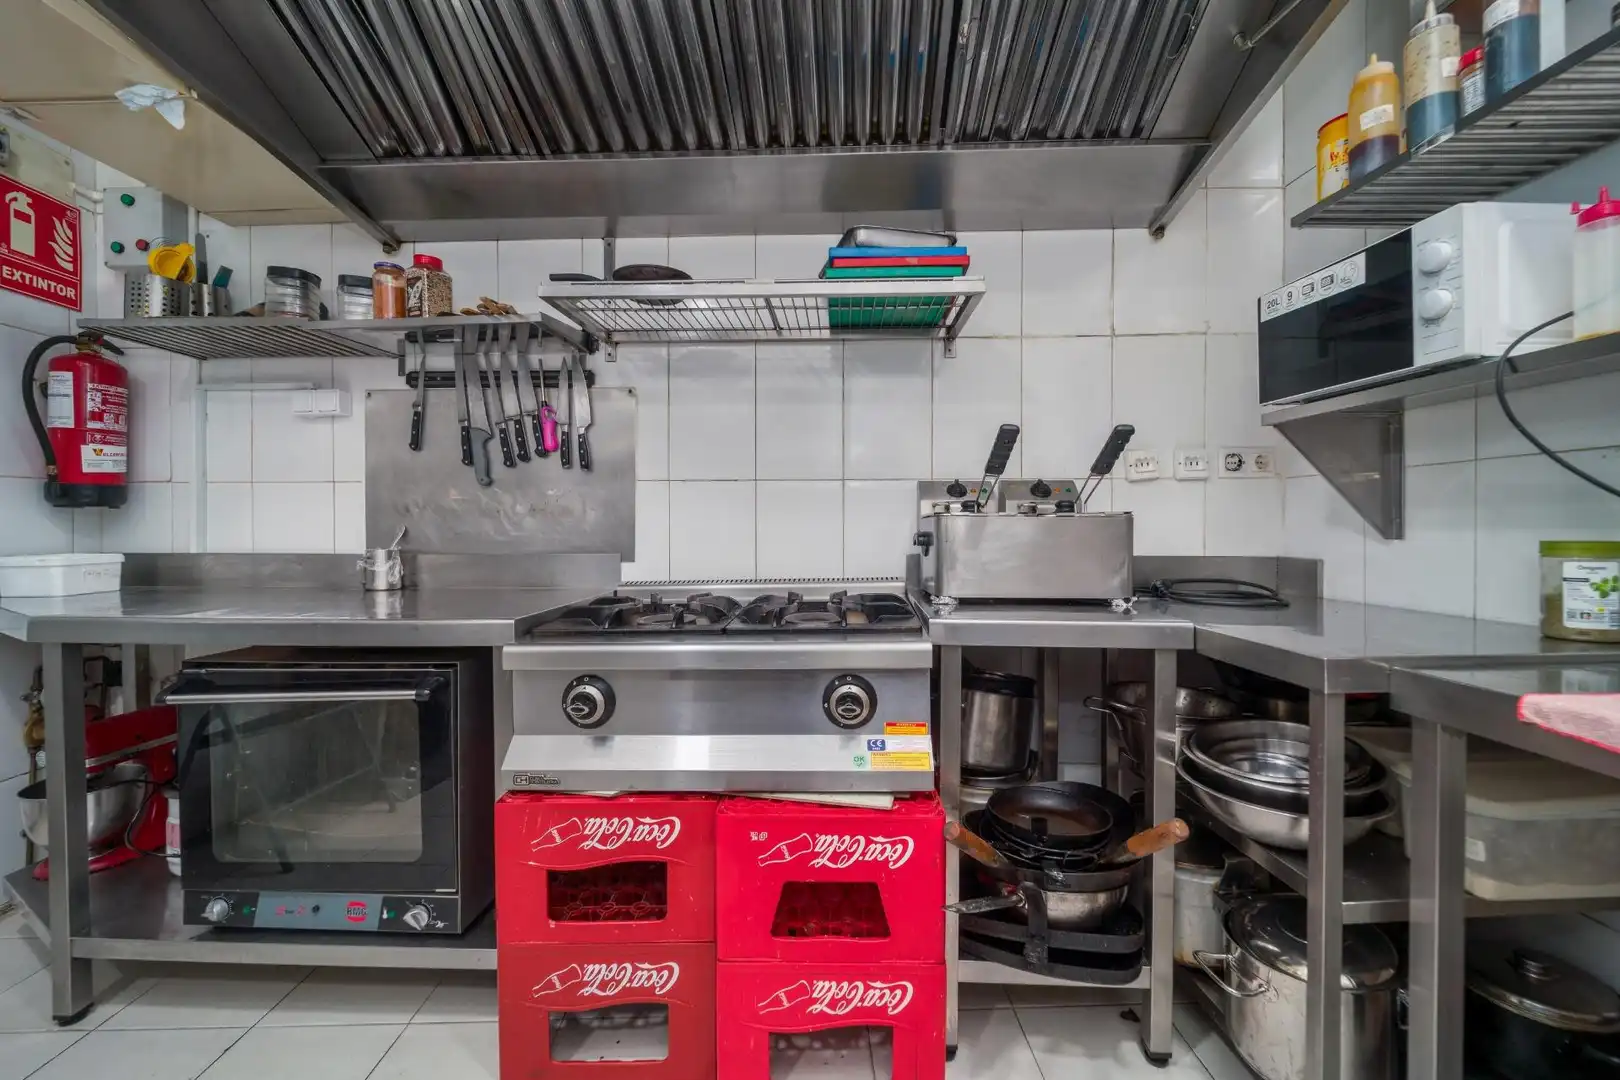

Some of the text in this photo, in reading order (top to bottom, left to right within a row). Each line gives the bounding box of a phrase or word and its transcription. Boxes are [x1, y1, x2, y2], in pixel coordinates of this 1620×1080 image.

[2, 265, 77, 300] EXTINTOR
[1287, 291, 1293, 302] 9
[1266, 297, 1281, 310] 20L
[577, 816, 682, 850] Coca-Cola
[808, 833, 915, 870] Coca-Cola
[576, 961, 680, 997] Coca-Cola
[805, 979, 914, 1015] Coca-Cola
